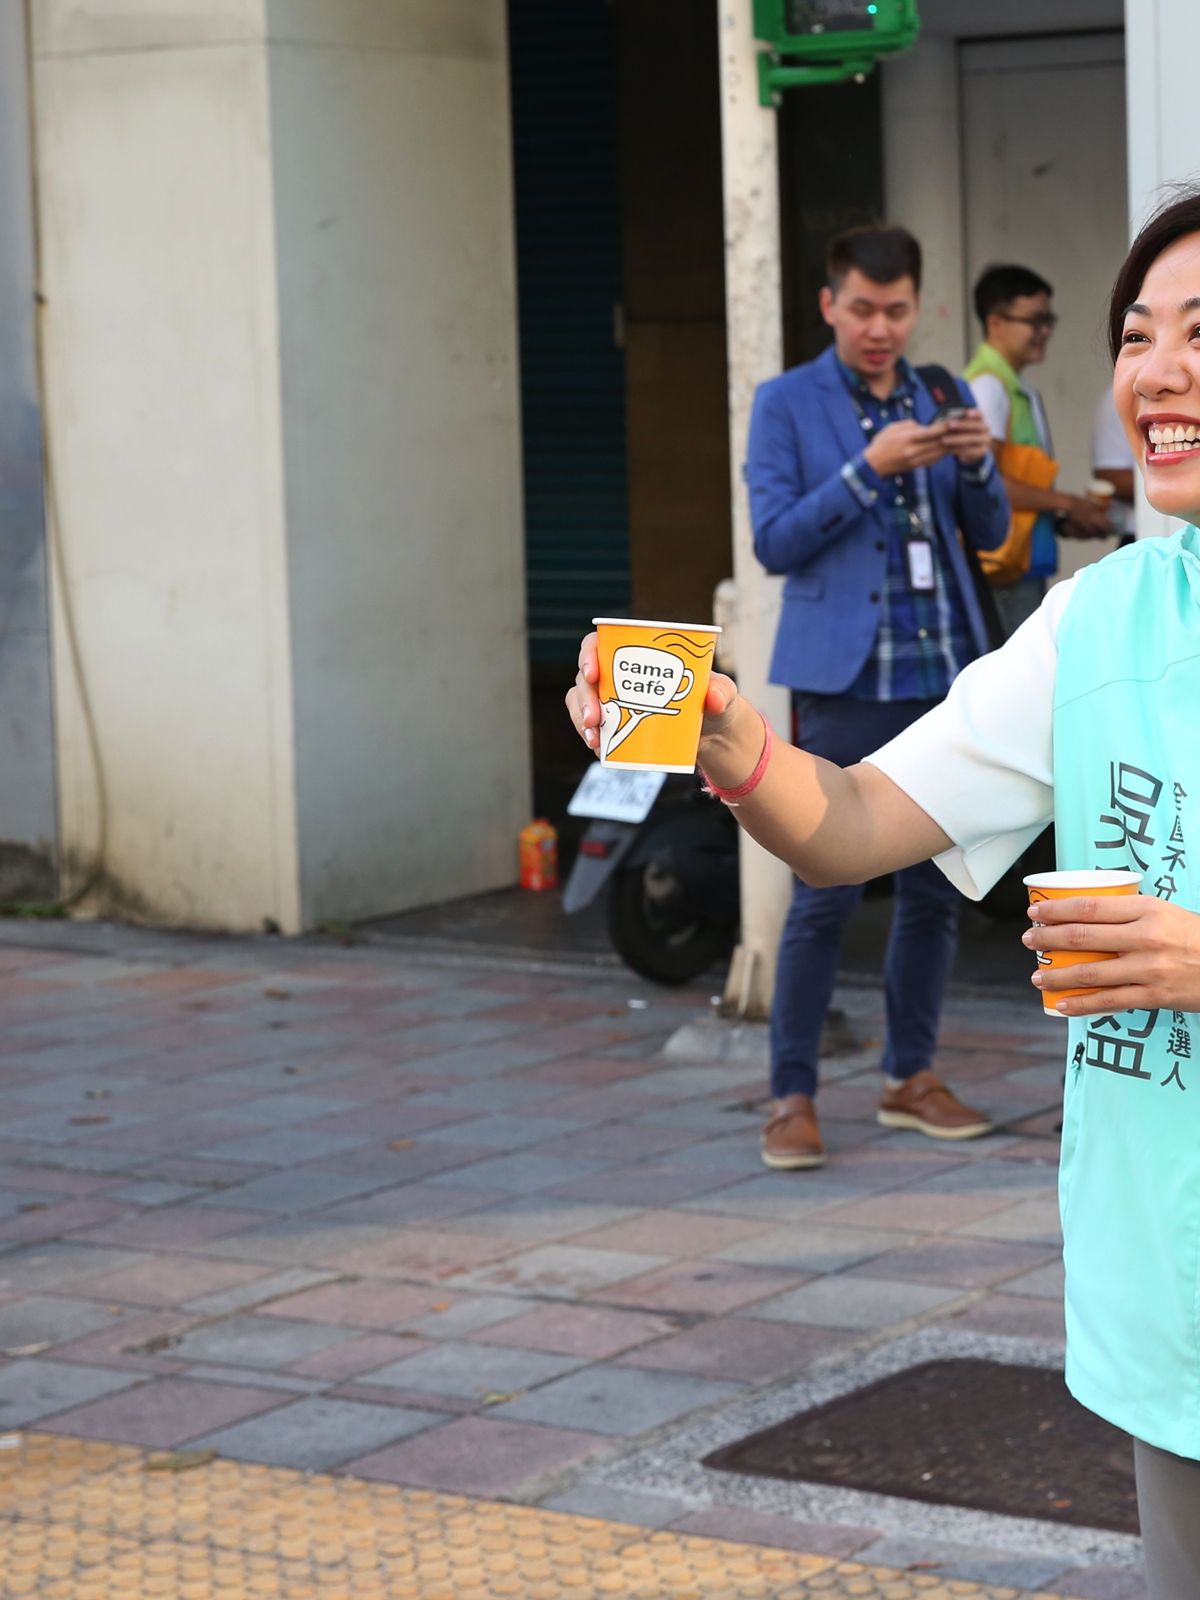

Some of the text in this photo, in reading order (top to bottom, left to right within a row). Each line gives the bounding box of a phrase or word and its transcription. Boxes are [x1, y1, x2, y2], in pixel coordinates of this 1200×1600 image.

[619, 660, 674, 679] cama
[621, 679, 665, 696] café
[1086, 761, 1163, 1080] 吳盈
